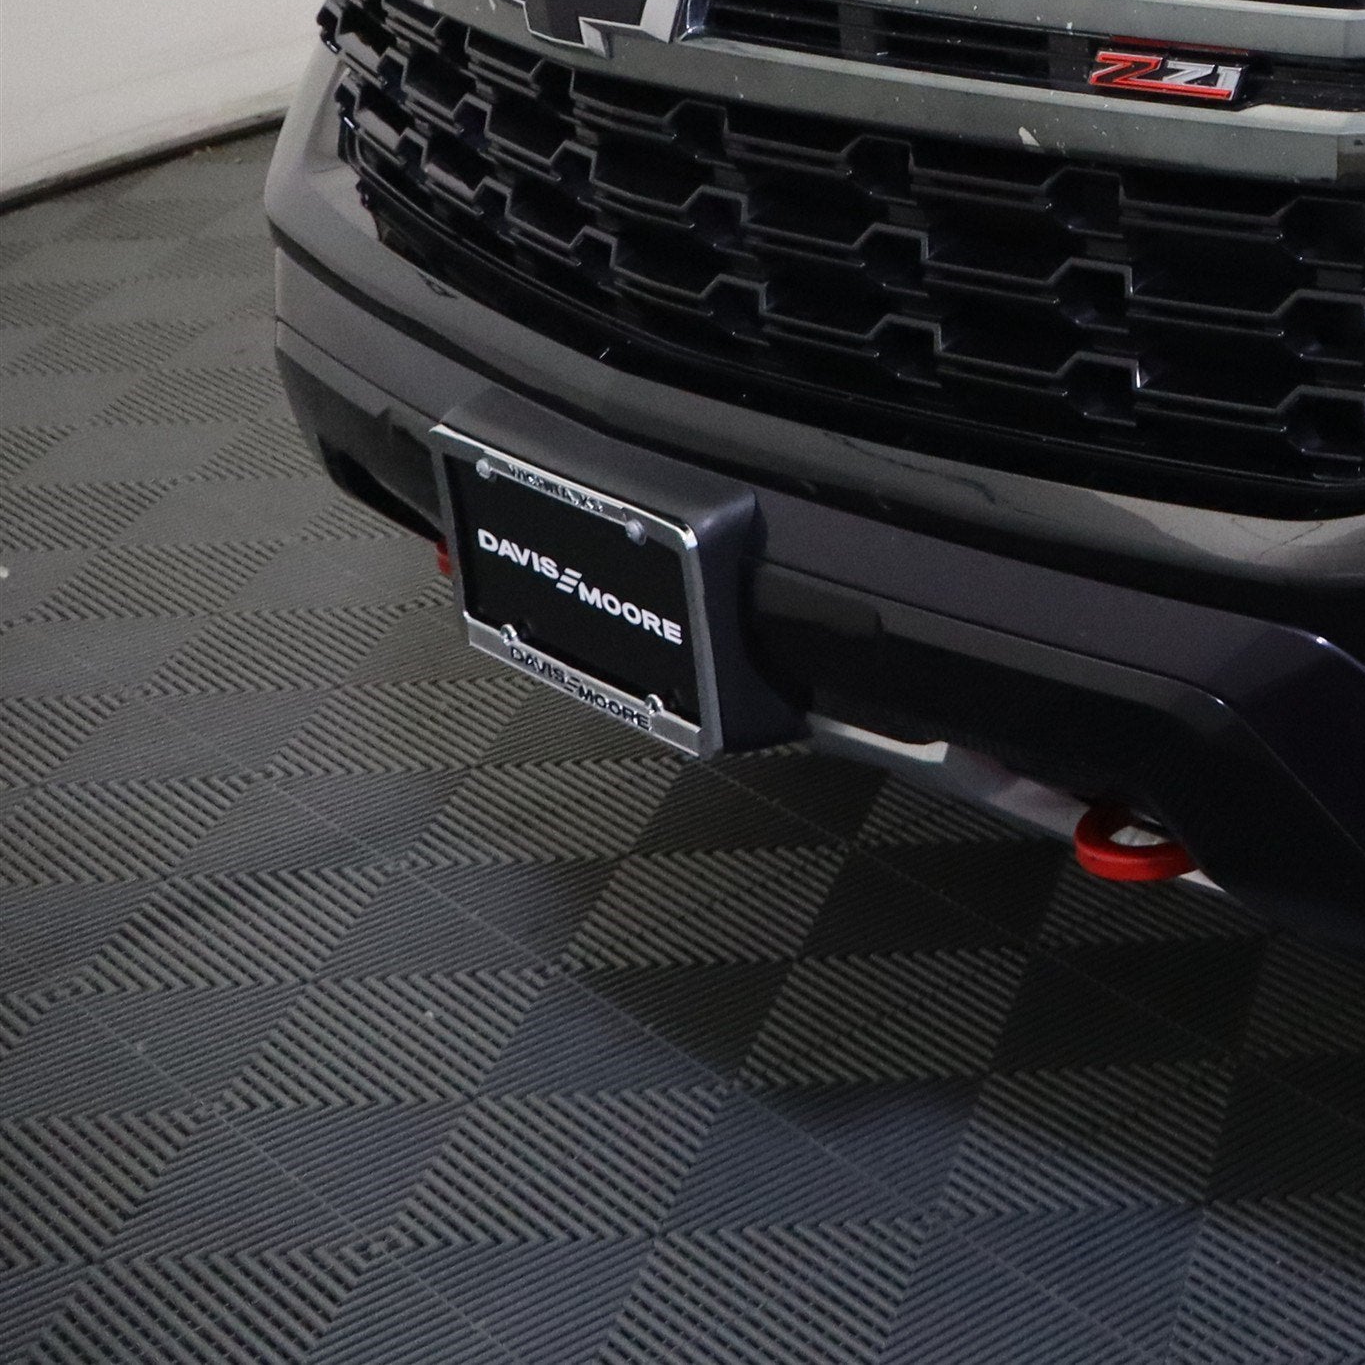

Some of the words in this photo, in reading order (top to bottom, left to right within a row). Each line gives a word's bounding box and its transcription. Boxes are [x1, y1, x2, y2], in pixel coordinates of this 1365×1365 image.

[1088, 50, 1244, 102] Z71
[477, 528, 560, 580] DAVIS
[577, 581, 684, 645] MOORE
[510, 646, 566, 684] DAVIS
[578, 685, 651, 731] MOORE
